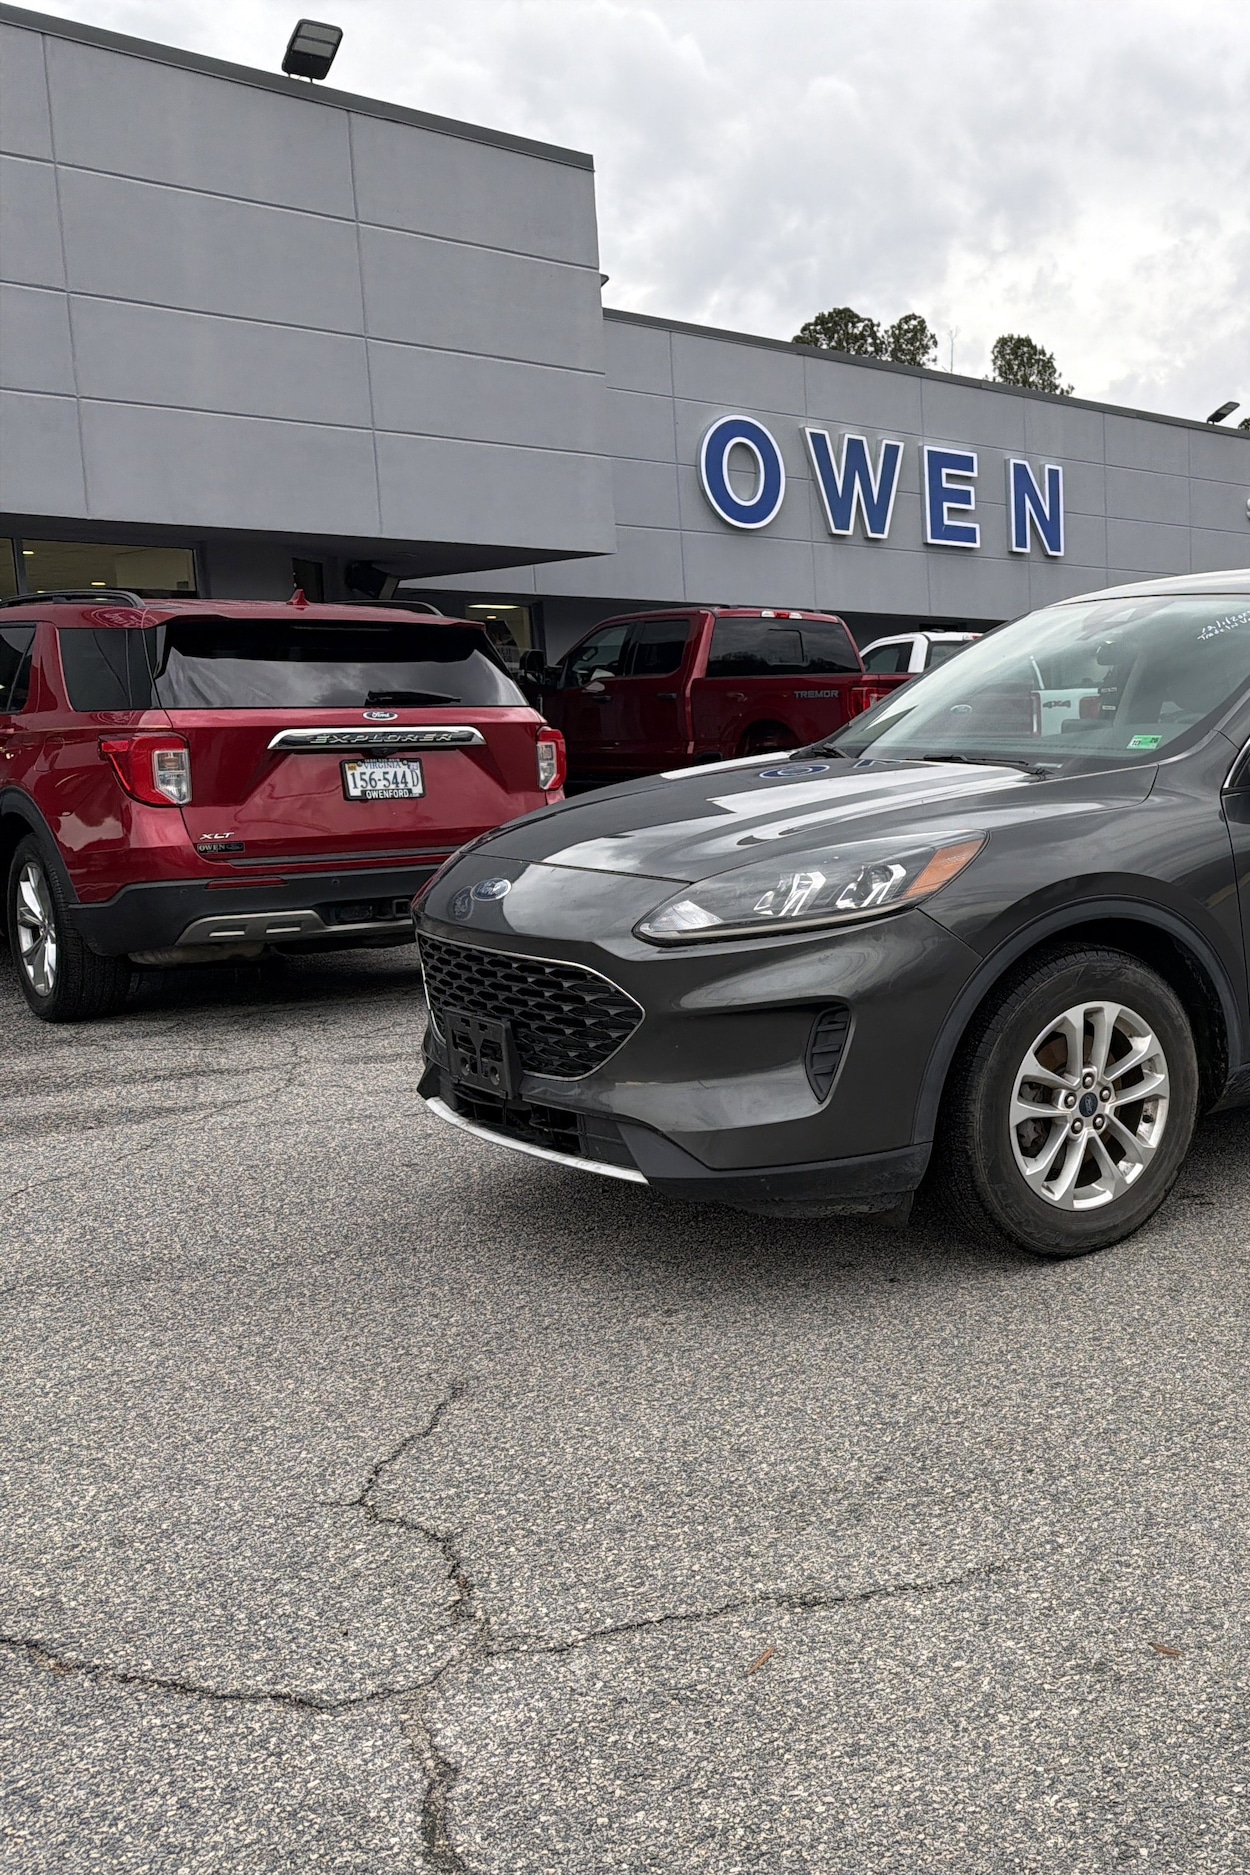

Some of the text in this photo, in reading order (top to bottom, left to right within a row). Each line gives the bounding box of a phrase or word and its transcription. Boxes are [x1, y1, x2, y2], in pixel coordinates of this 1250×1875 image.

[699, 413, 1064, 557] OWEN
[793, 690, 840, 699] TREMOR
[310, 733, 453, 744] EXPLORER
[363, 761, 402, 770] VIRGINIA
[200, 832, 236, 840] XLT
[198, 843, 226, 852] OWEN
